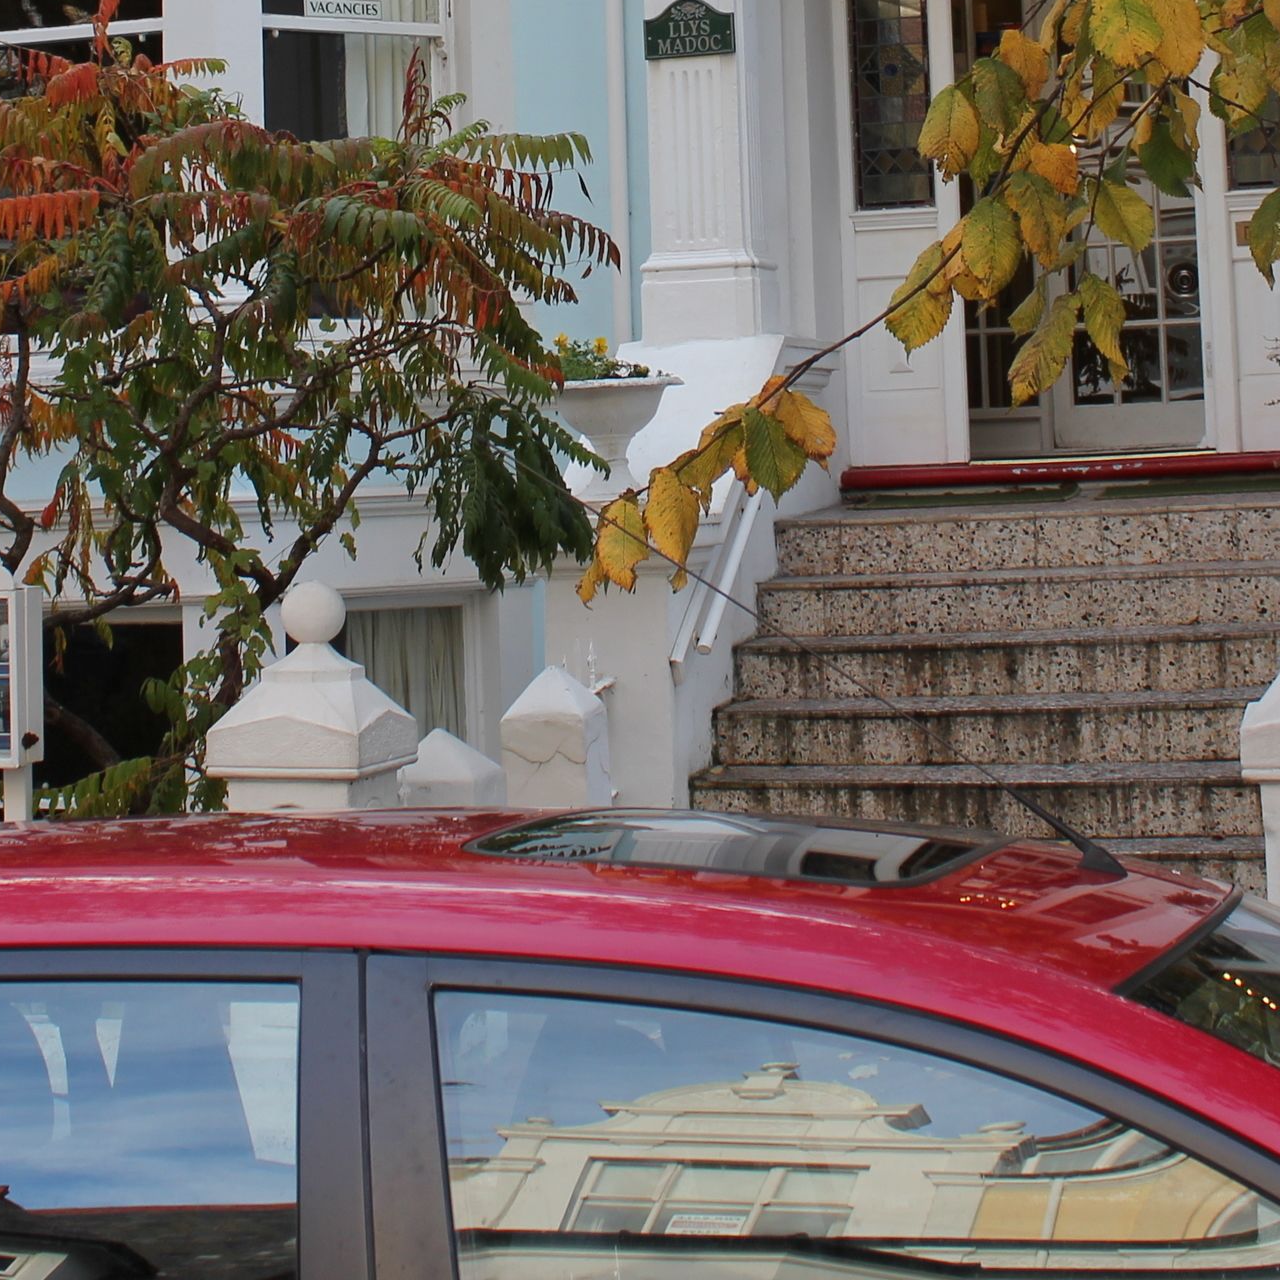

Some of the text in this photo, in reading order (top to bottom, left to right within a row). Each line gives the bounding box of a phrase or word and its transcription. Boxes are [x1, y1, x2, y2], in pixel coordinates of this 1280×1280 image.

[309, 1, 378, 16] VACANCIES
[669, 20, 710, 38] LLYS
[658, 34, 721, 54] MADOC
